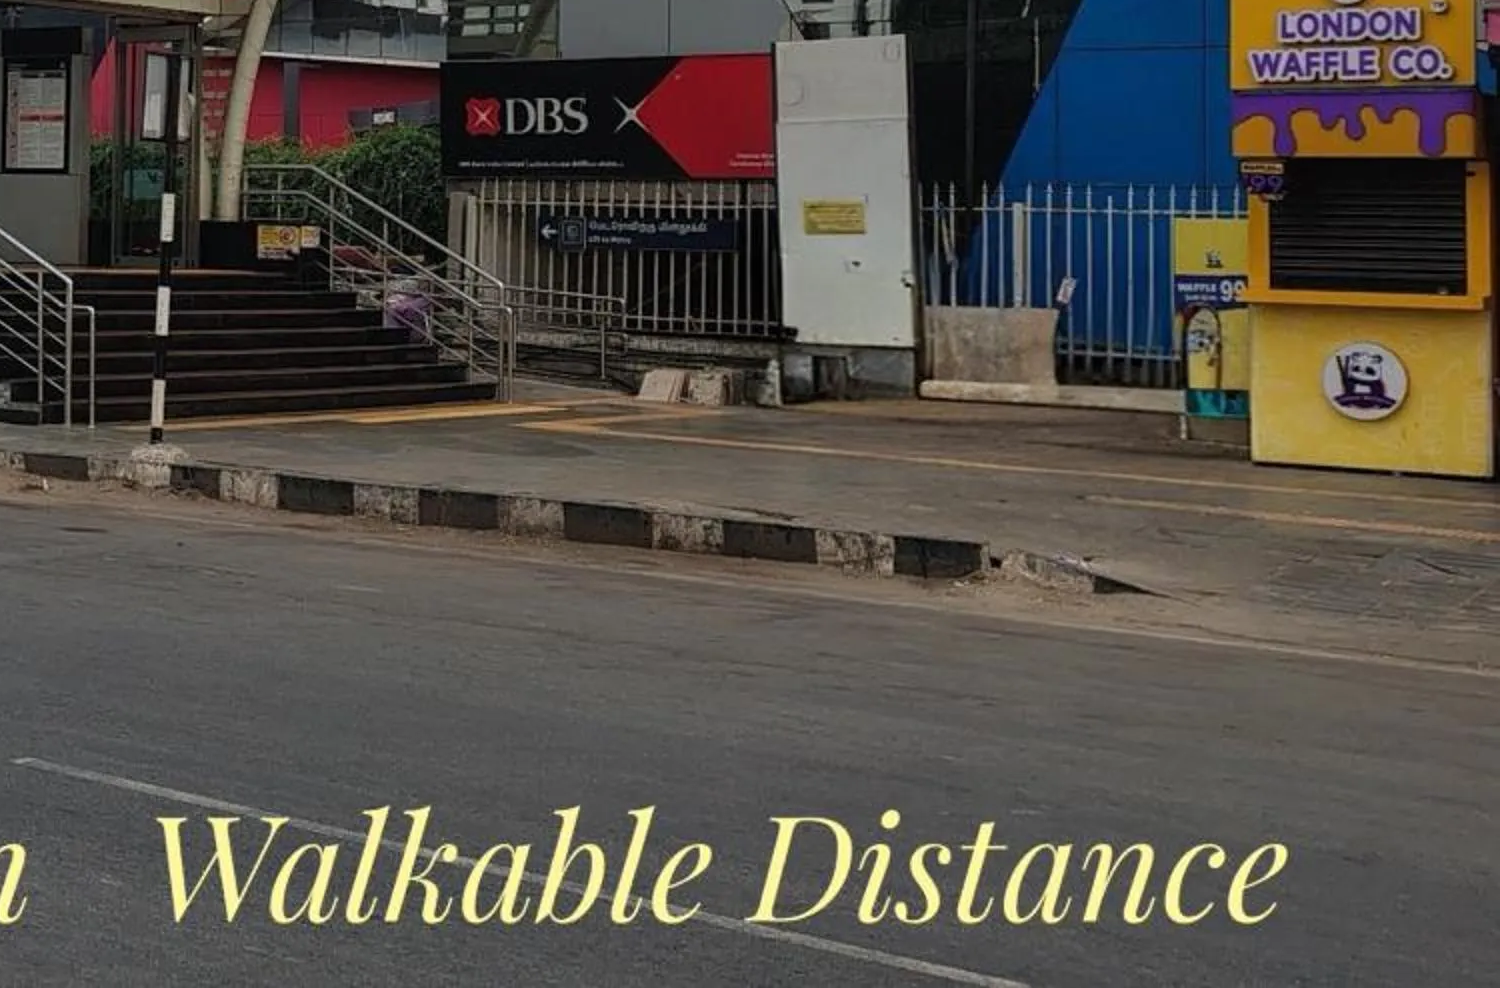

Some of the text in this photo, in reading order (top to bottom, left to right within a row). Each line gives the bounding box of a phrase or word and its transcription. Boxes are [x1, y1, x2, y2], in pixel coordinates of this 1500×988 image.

[1280, 10, 1417, 39] LONDON
[1252, 48, 1451, 78] WAFFLE CO.
[505, 96, 589, 135] DBS
